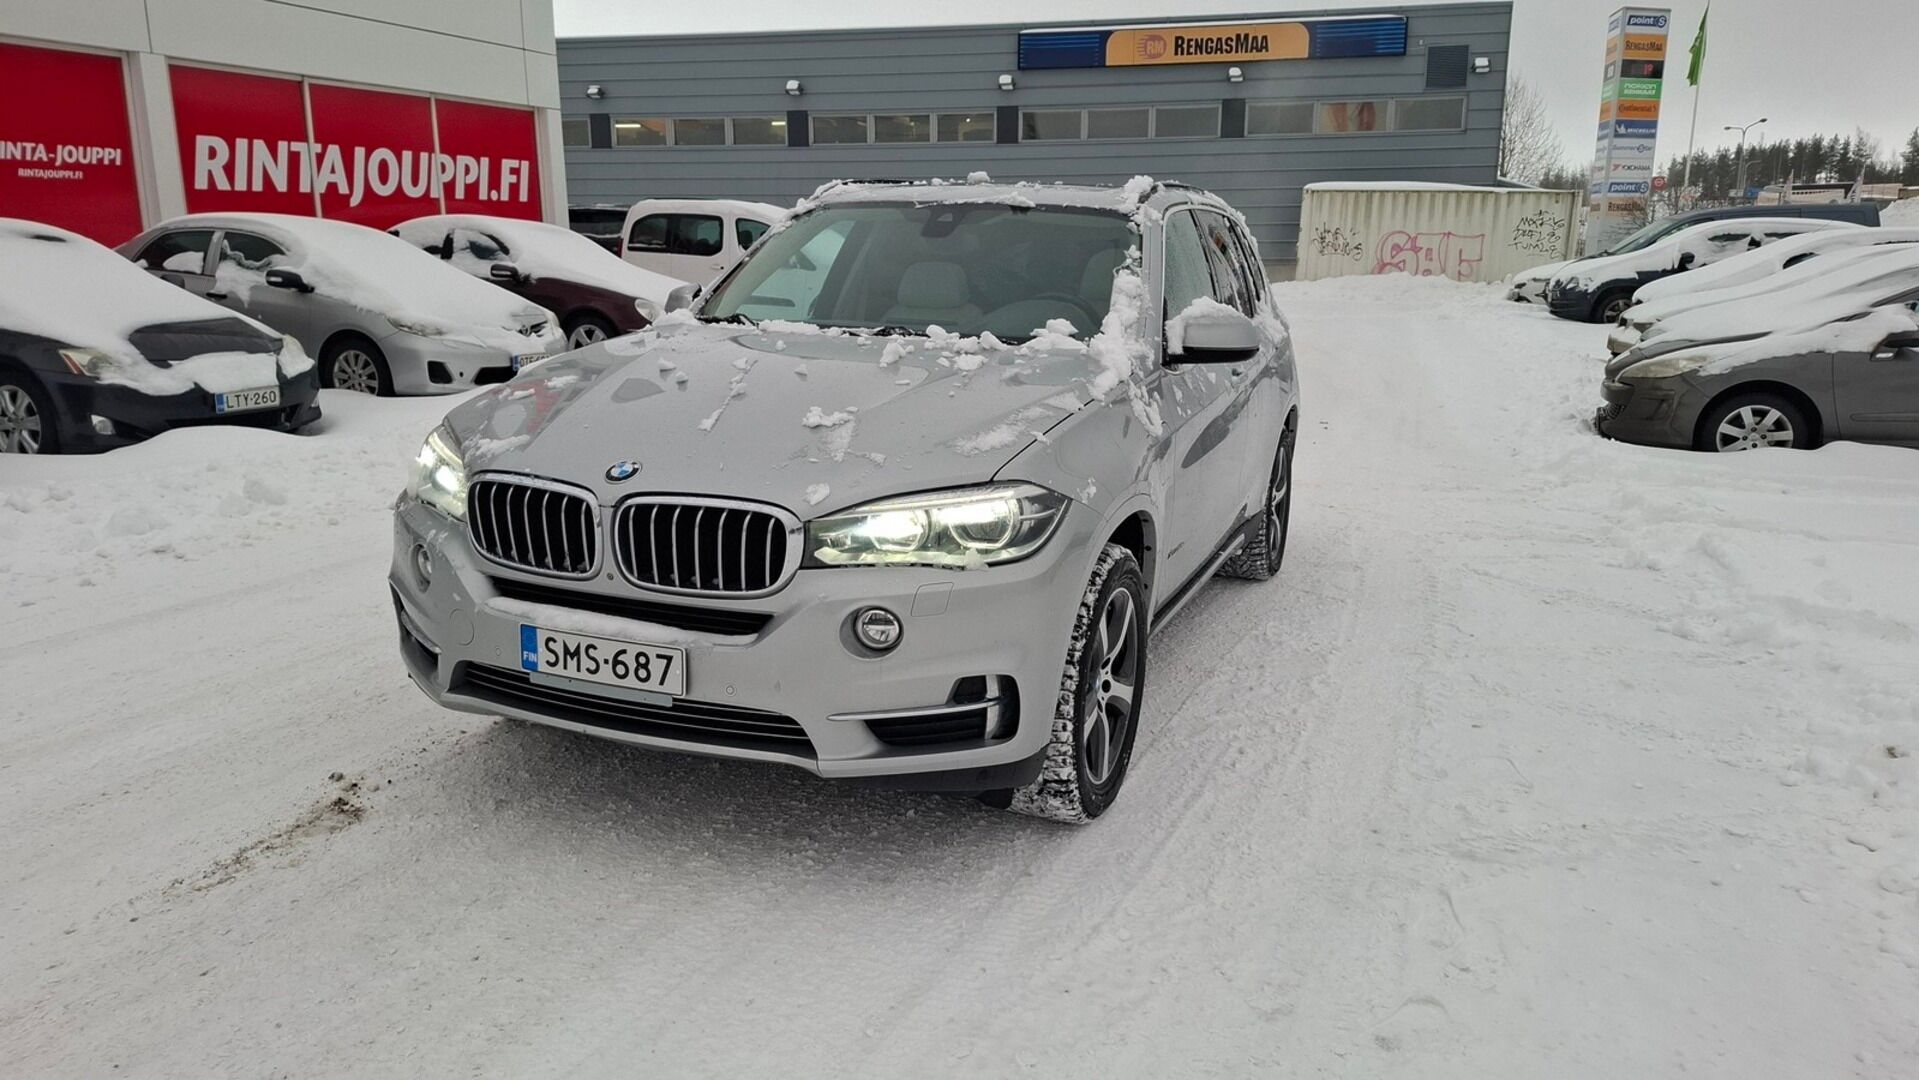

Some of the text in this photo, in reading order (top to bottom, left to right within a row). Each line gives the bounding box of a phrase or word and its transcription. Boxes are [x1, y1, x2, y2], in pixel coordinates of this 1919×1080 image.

[1629, 16, 1654, 25] point
[1174, 33, 1269, 56] RENGASMAA
[194, 135, 530, 207] RINTAJOUPPI.FI
[1611, 184, 1635, 192] point
[226, 390, 277, 409] LTY-260
[523, 651, 538, 663] FIN
[544, 636, 674, 686] SMS-687
